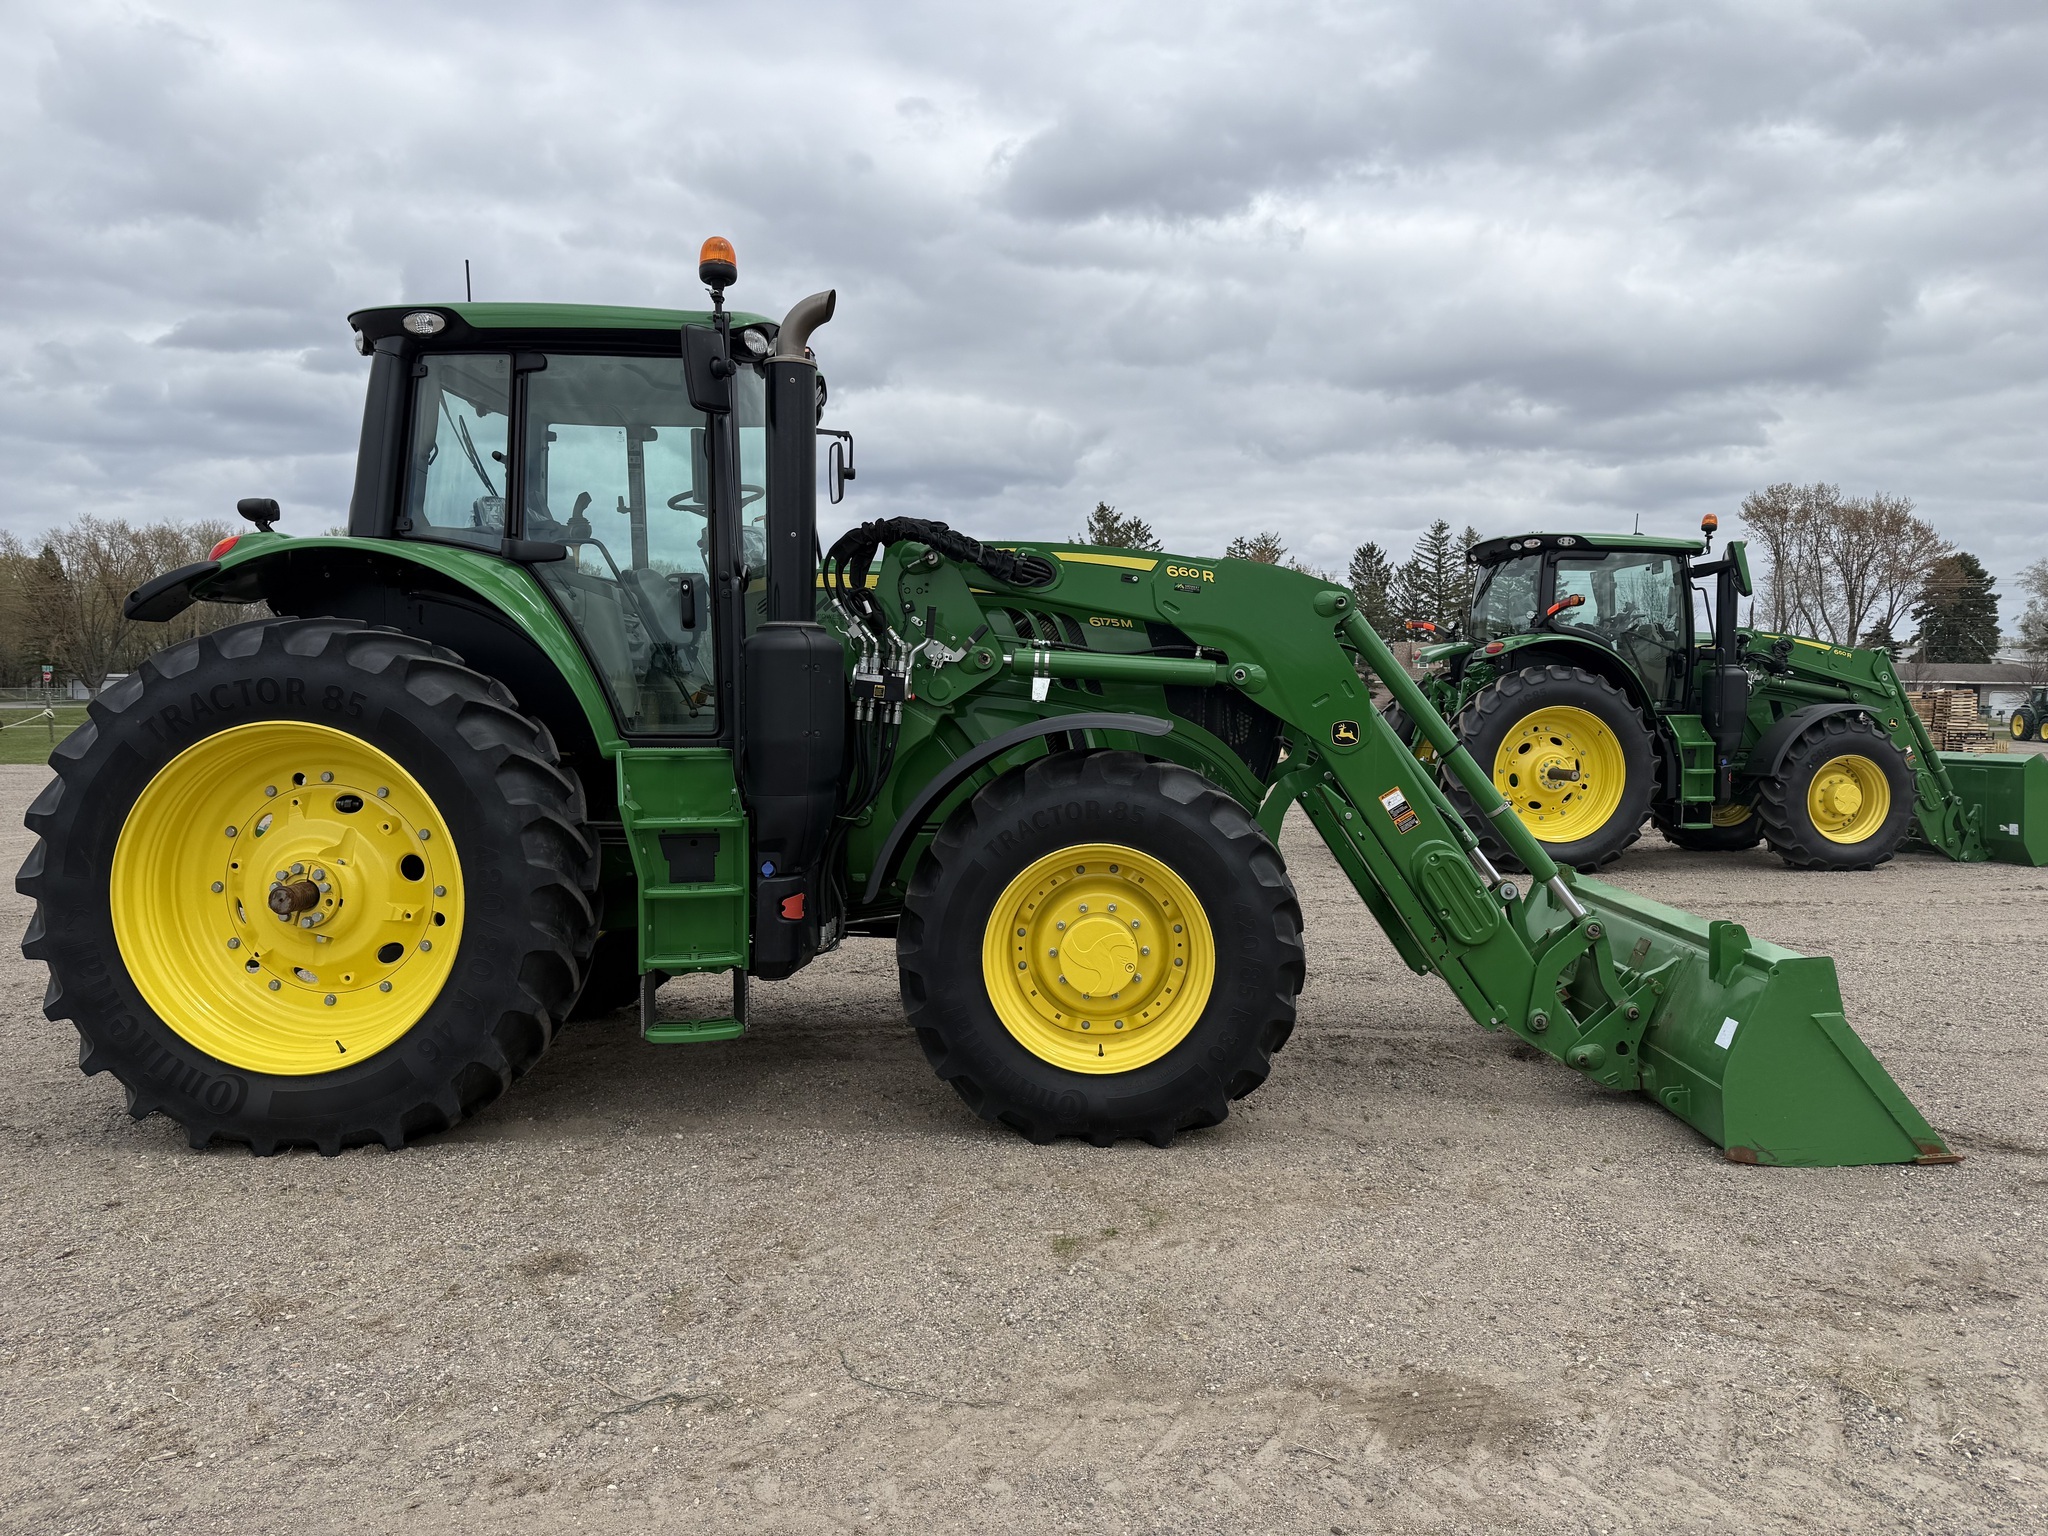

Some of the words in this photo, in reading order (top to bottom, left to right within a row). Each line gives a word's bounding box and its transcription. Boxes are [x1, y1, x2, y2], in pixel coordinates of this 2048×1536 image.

[1166, 565, 1200, 579] 660
[1202, 569, 1215, 583] R
[1089, 616, 1133, 628] 6175M
[140, 676, 308, 744] TRACTOR
[322, 685, 368, 719] 85
[984, 799, 1105, 858] TRACTOR
[1114, 801, 1147, 826] 85
[60, 942, 250, 1115] Continental
